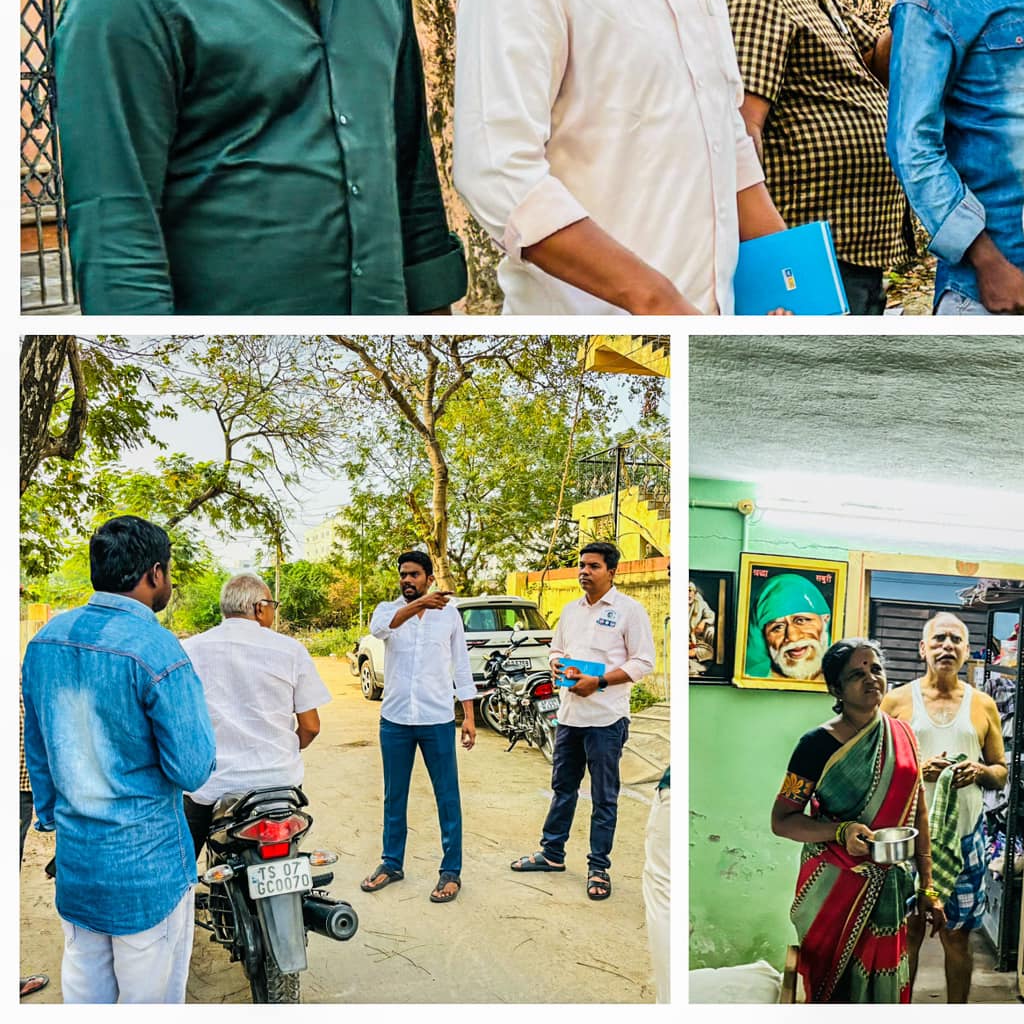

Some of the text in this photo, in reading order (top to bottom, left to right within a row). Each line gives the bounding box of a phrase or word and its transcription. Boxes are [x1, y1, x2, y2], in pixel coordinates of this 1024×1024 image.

[258, 861, 301, 880] TS 07
[257, 874, 309, 895] GC0070
